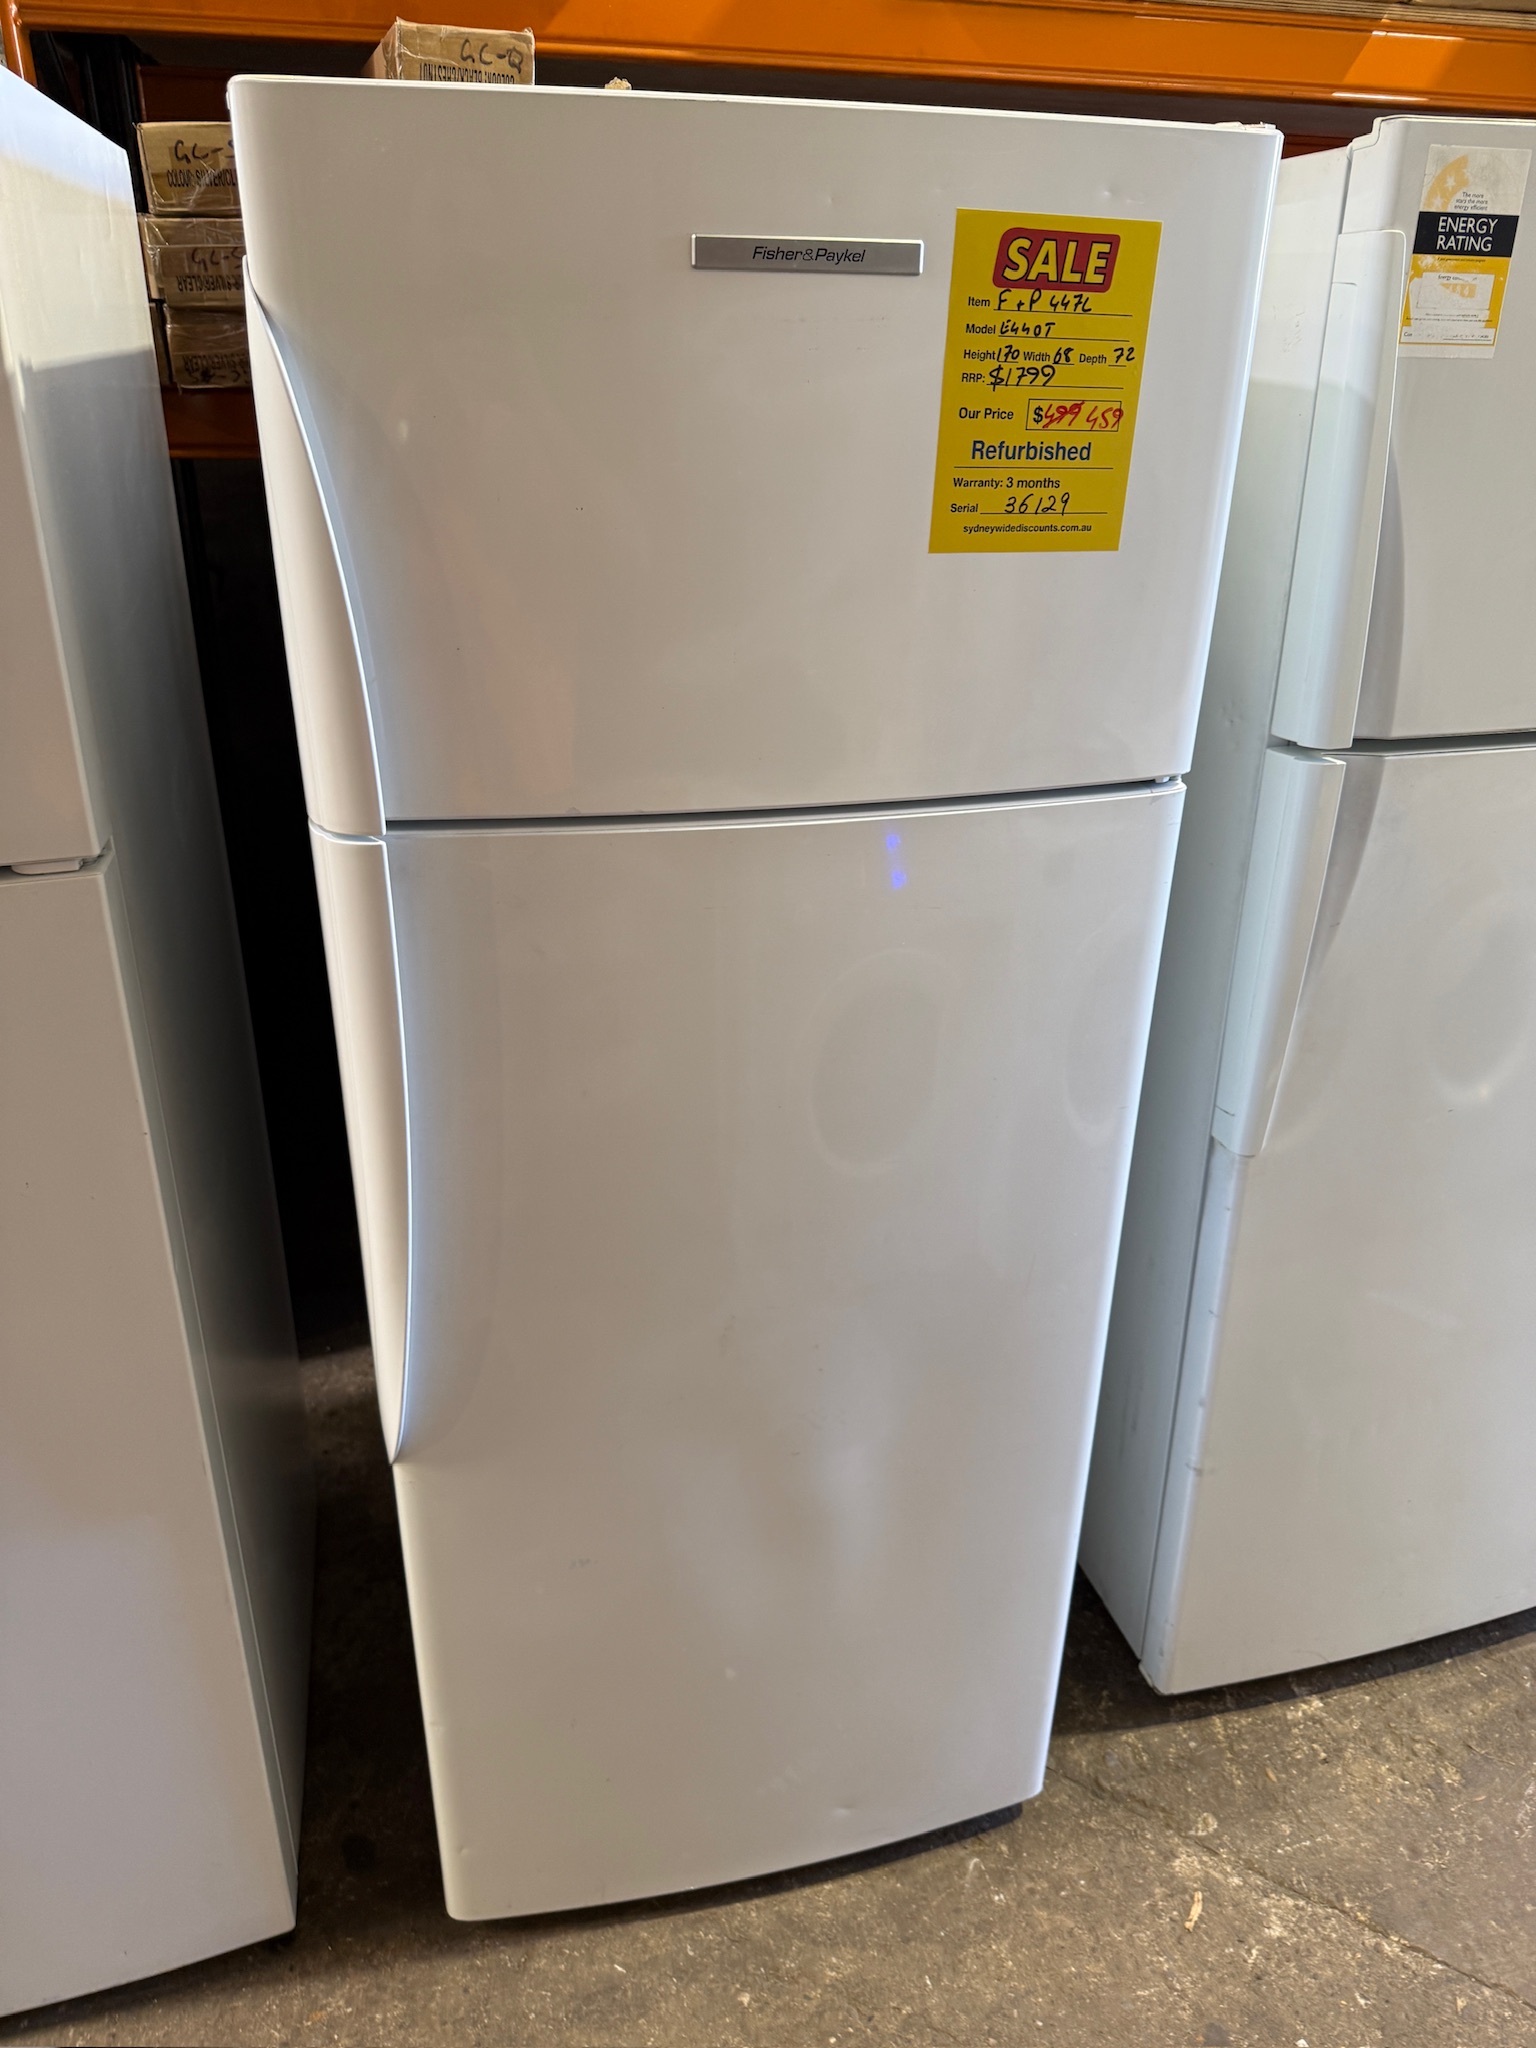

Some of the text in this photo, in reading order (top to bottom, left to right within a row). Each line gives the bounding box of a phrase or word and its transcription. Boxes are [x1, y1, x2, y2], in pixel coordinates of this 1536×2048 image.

[1438, 216, 1498, 234] ENERGY
[1436, 235, 1492, 252] RATING
[752, 246, 866, 265] Fisher&Paykel
[1002, 237, 1112, 285] SALE
[968, 296, 990, 308] Item
[966, 323, 996, 335] Model
[964, 344, 1135, 366] Height 170 Width 68 Depth 72
[961, 364, 1056, 392] RRP: $1799
[959, 407, 980, 419] Our
[984, 408, 1014, 420] Price
[972, 440, 1091, 462] Refurbished
[953, 477, 1061, 489] Warranty: 3 months
[950, 492, 1070, 515] Serial 36129
[963, 523, 1092, 534] sydneywidediscounts.com.au
